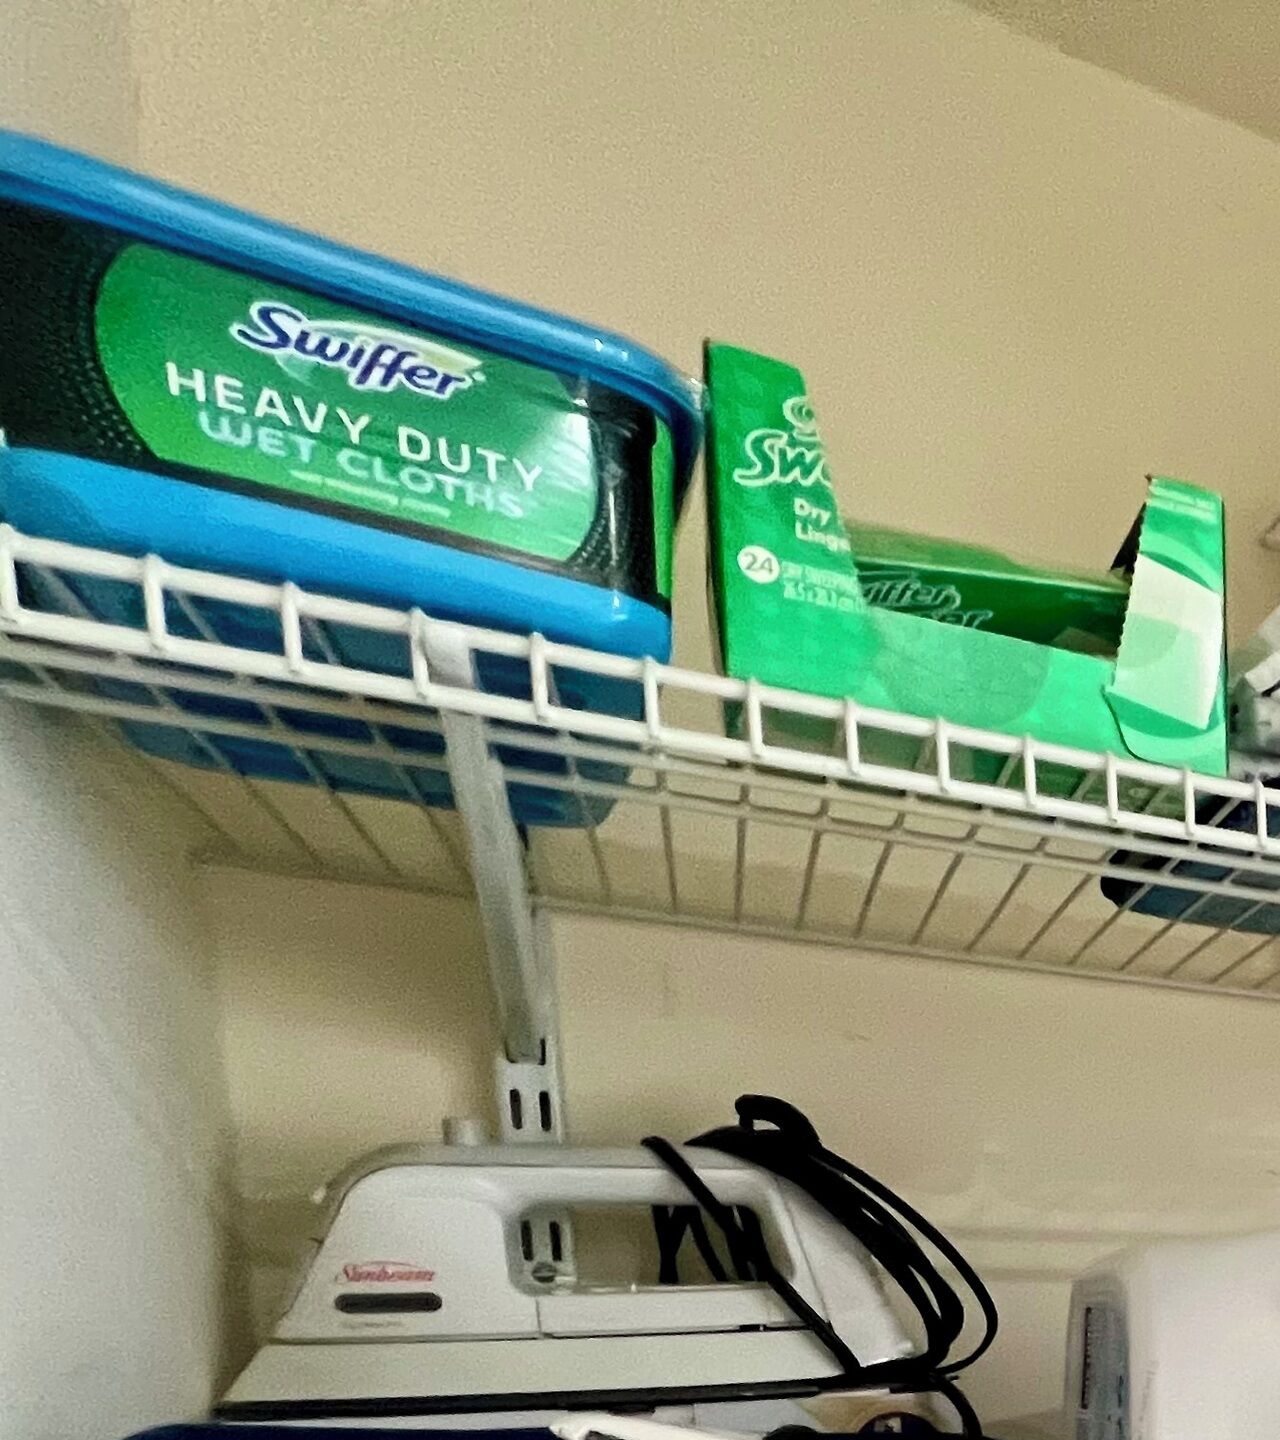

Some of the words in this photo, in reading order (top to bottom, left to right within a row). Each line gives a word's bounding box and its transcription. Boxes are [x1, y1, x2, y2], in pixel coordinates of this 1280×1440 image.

[232, 300, 472, 399] Swiffer
[166, 361, 371, 445] HEAVY
[397, 423, 544, 493] DUTY
[198, 411, 316, 465] WET
[337, 445, 526, 518] CLOTHS
[733, 428, 832, 487] Sw
